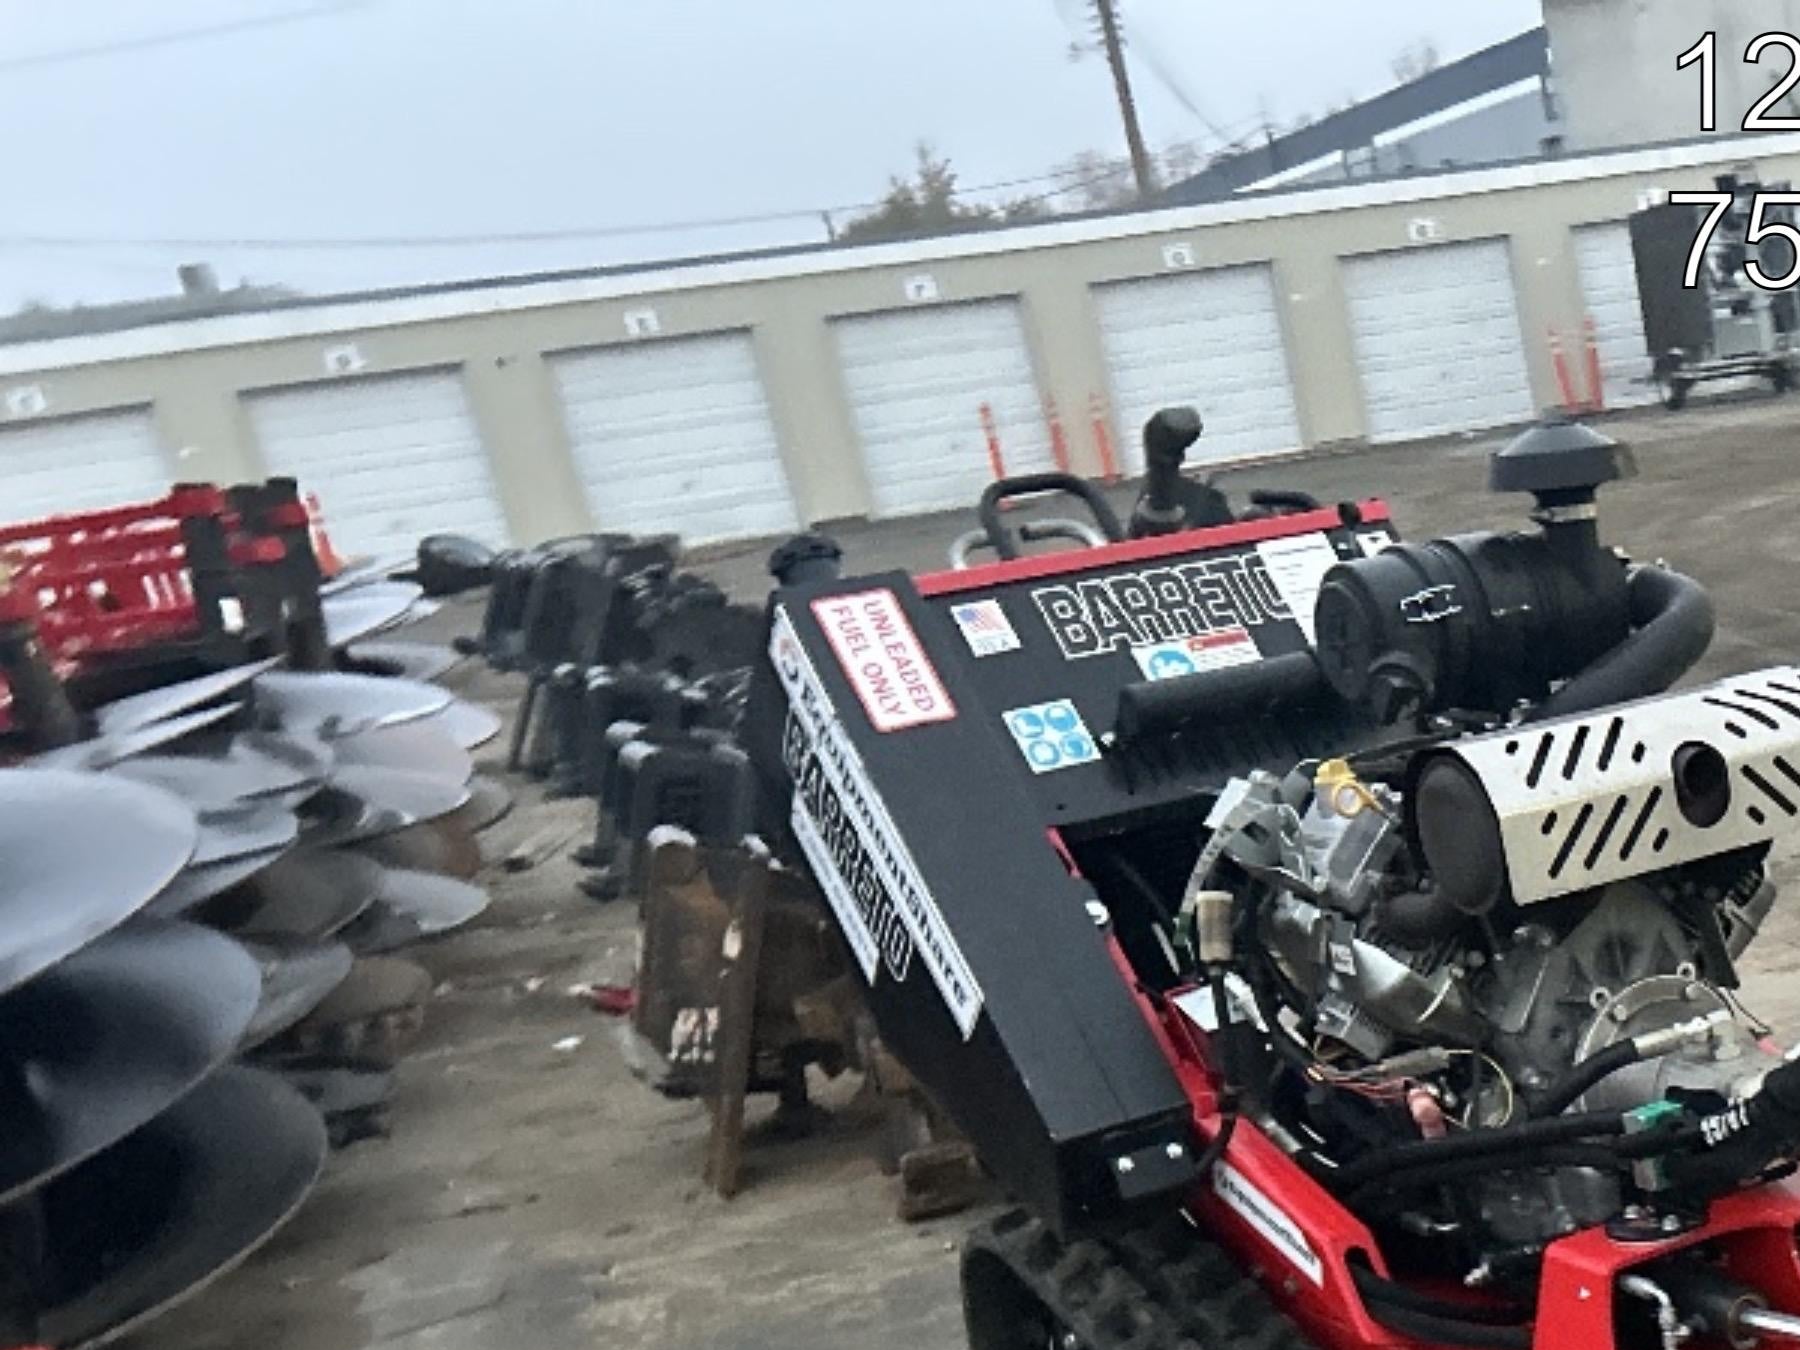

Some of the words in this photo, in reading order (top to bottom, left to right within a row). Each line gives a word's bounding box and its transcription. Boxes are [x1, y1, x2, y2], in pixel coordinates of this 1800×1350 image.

[831, 604, 871, 657] FUEL
[863, 661, 906, 715] ONLY
[863, 598, 936, 712] UNLEADED
[783, 708, 914, 982] BARRETO
